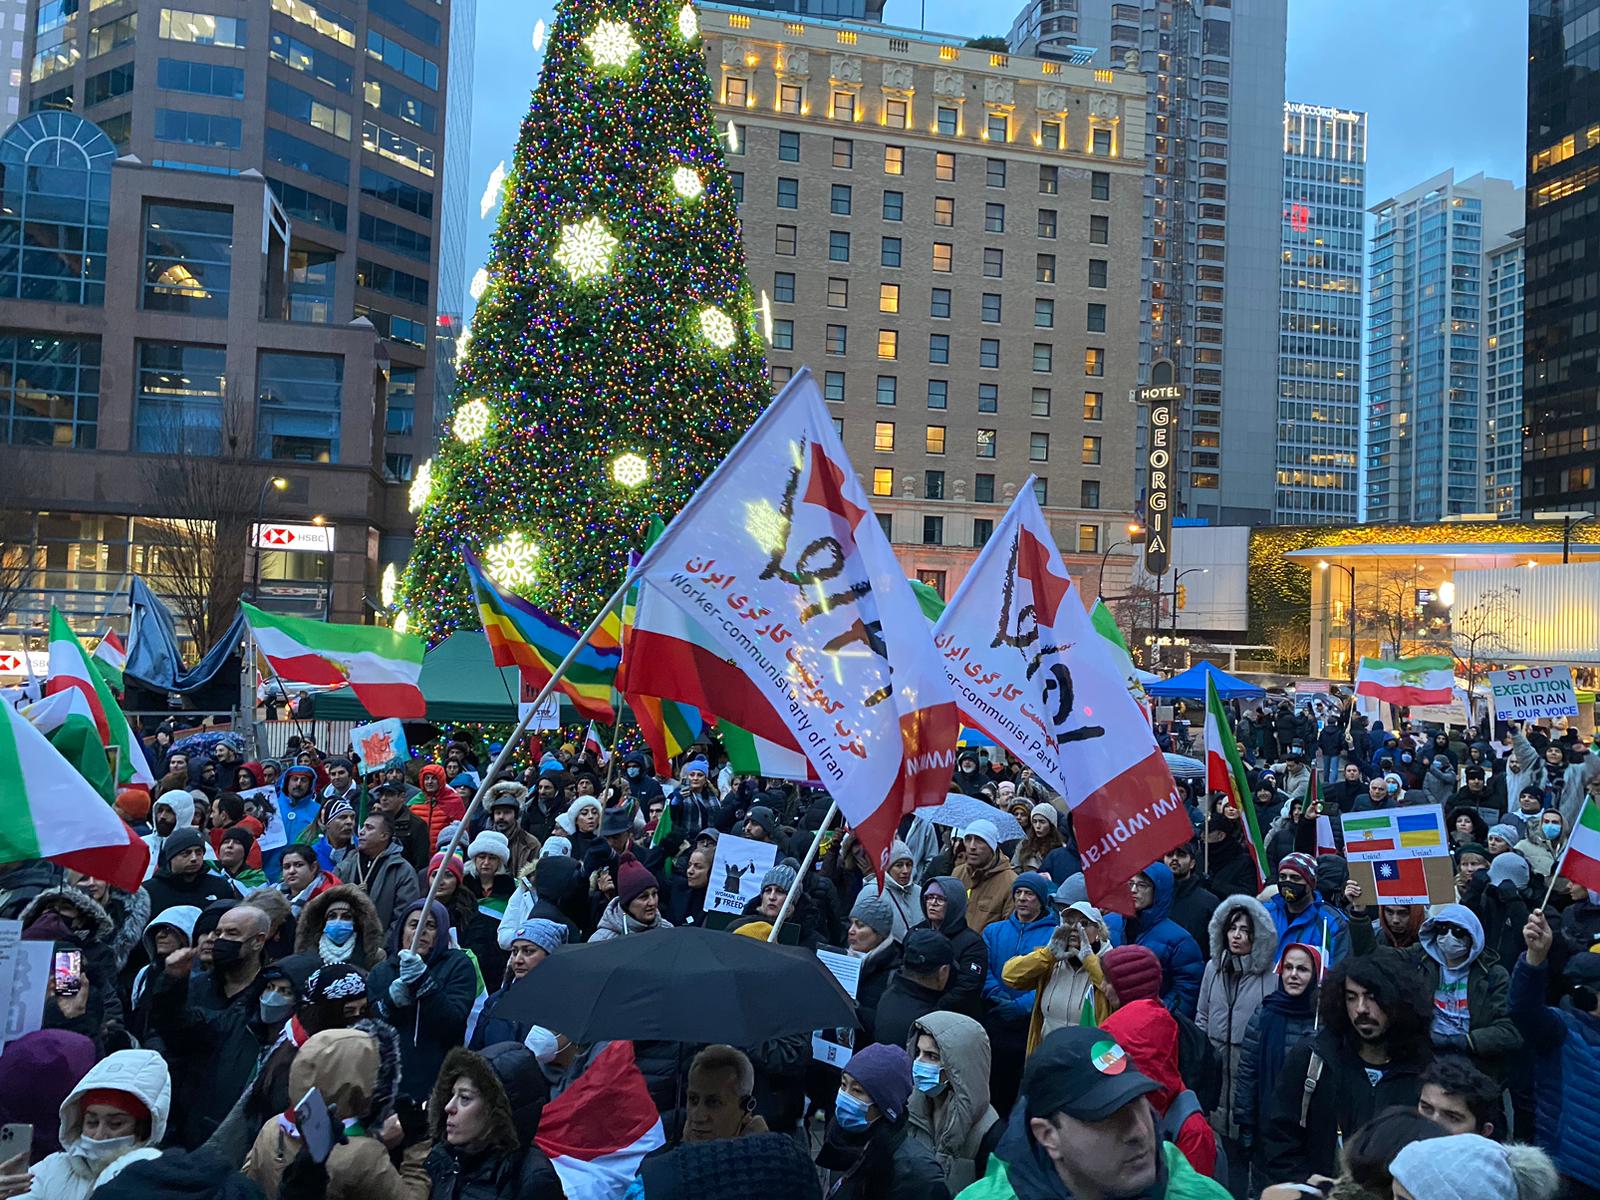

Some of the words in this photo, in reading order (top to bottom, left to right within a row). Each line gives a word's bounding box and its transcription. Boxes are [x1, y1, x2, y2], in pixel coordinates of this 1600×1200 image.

[1141, 387, 1181, 399] HOTEL
[1149, 407, 1169, 553] GEORGIA
[298, 534, 325, 542] HSBC
[685, 556, 736, 589] ایران
[934, 633, 970, 662] ایران
[670, 572, 790, 694] Worker-communist
[787, 689, 812, 731] Party
[808, 731, 826, 746] of
[819, 745, 844, 781] Iran
[1507, 667, 1553, 681] STOP
[1493, 680, 1571, 696] EXECUTION
[1513, 695, 1527, 707] IN
[1531, 693, 1567, 706] IRAN
[1498, 711, 1513, 720] BE
[1517, 709, 1540, 718] OUR
[1545, 706, 1577, 716] VOICE
[1029, 740, 1059, 774] Party
